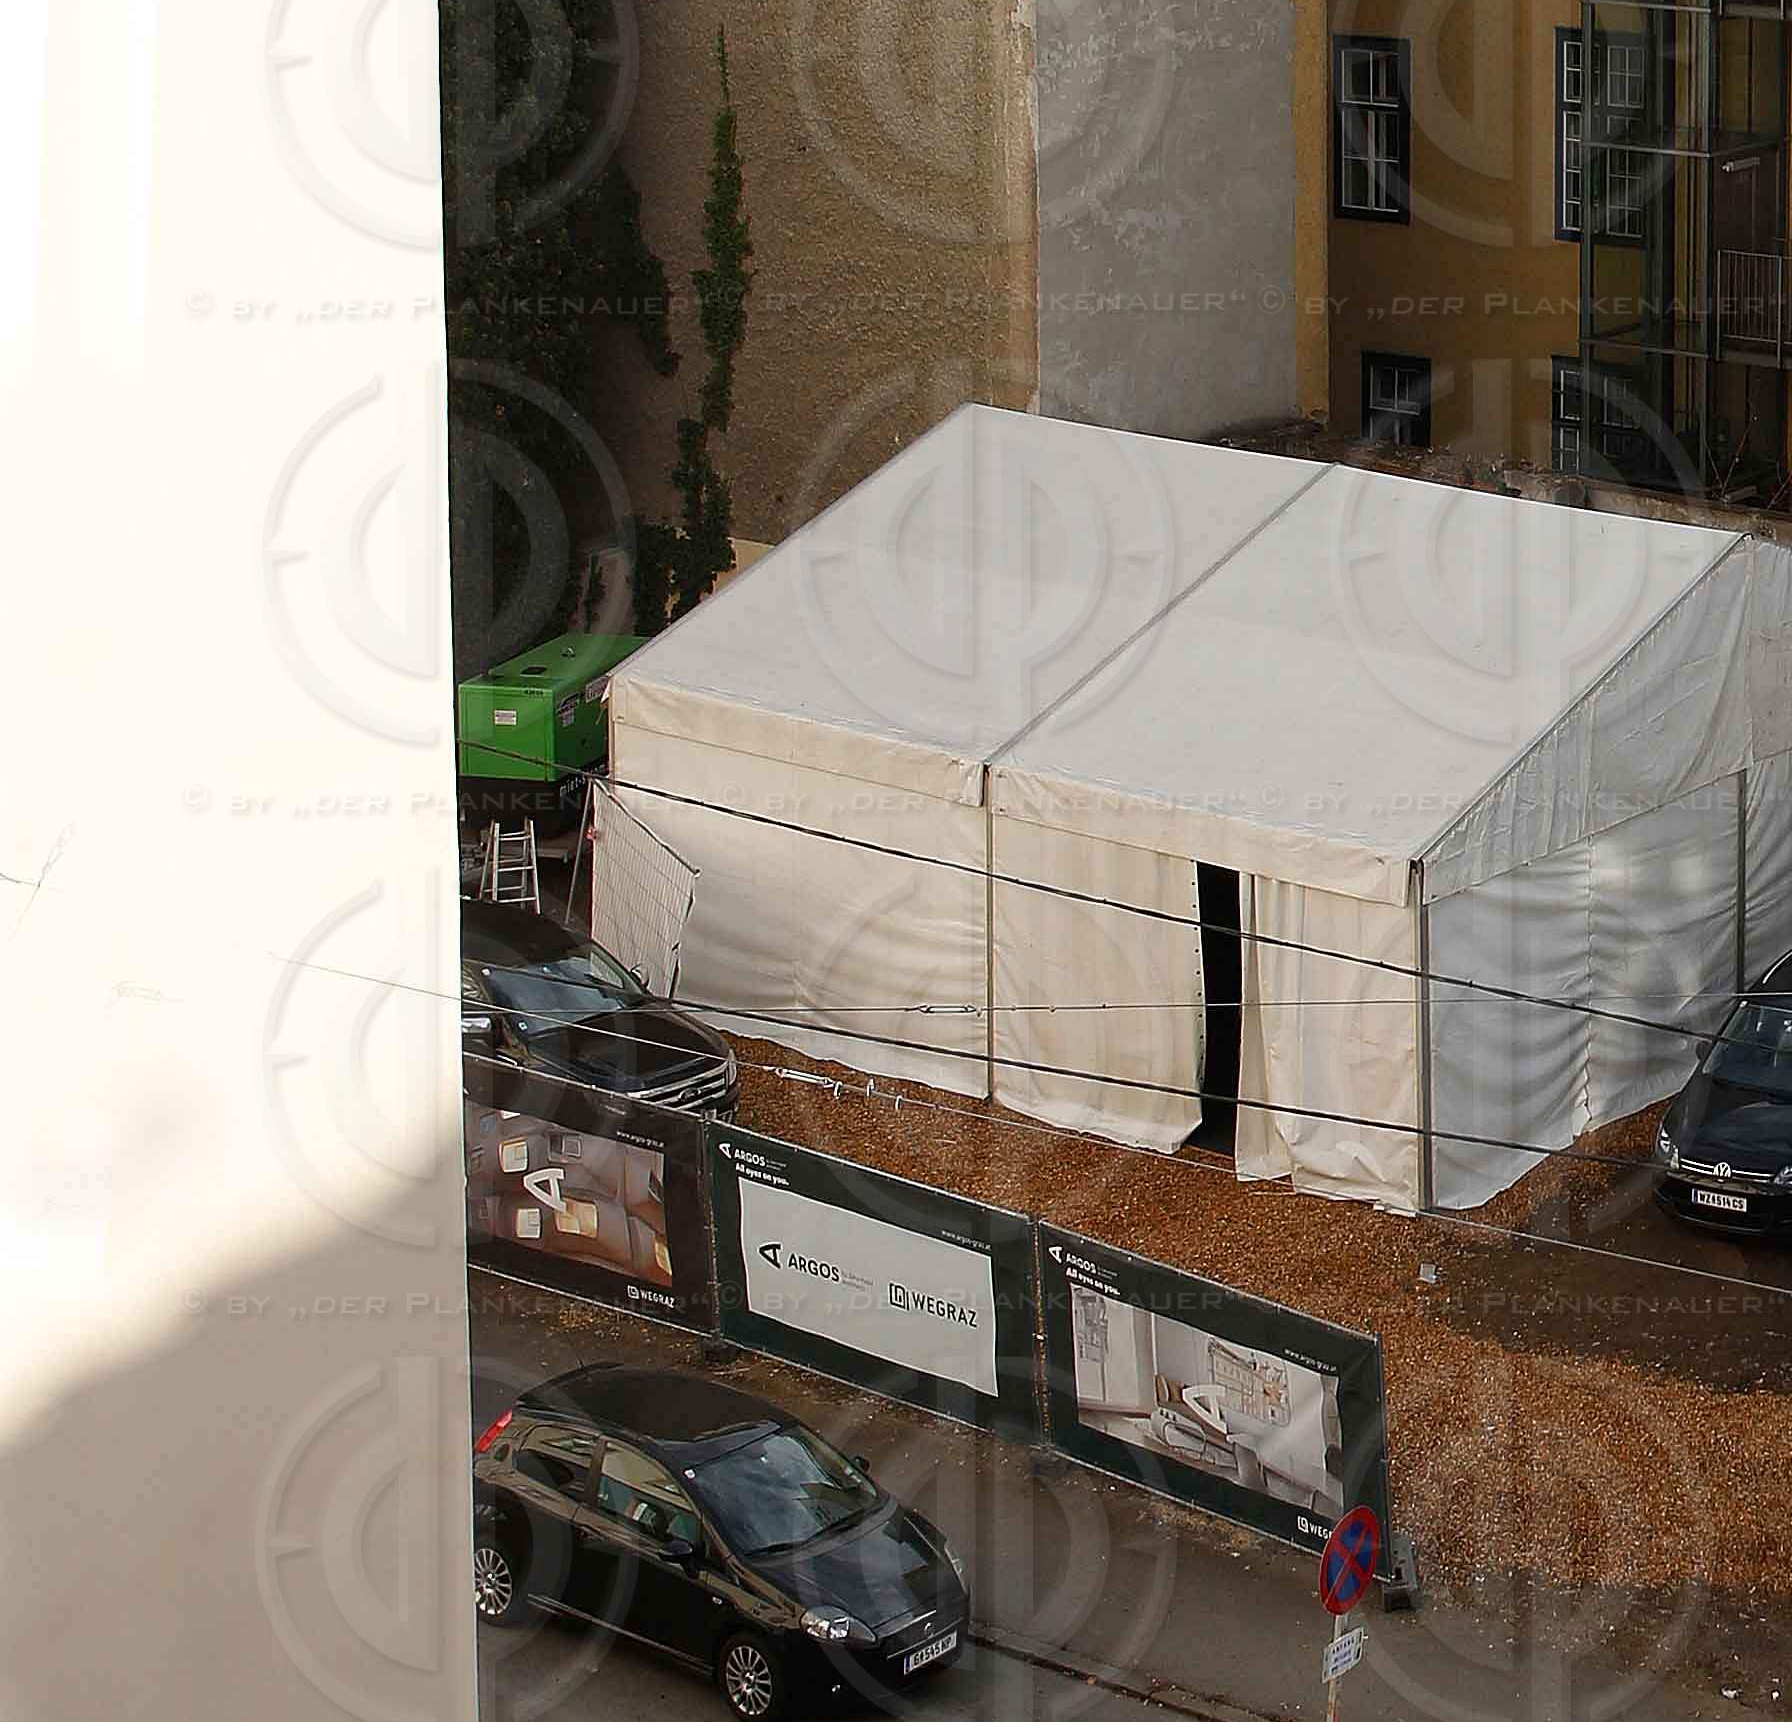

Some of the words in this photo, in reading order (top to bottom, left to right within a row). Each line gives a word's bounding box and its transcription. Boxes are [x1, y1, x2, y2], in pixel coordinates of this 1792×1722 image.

[734, 1148, 766, 1167] ARGOS
[735, 1162, 745, 1173] All
[745, 1167, 762, 1178] eyes
[762, 1172, 772, 1181] on
[772, 1175, 790, 1185] you.
[788, 1253, 840, 1282] ARGOS
[1065, 1252, 1097, 1274] ARGOS
[1065, 1266, 1078, 1279] All
[1078, 1272, 1094, 1286] eyes
[1094, 1279, 1104, 1290] on
[639, 1289, 675, 1309] WEGRAZ
[911, 1291, 978, 1328] WEGRAZ
